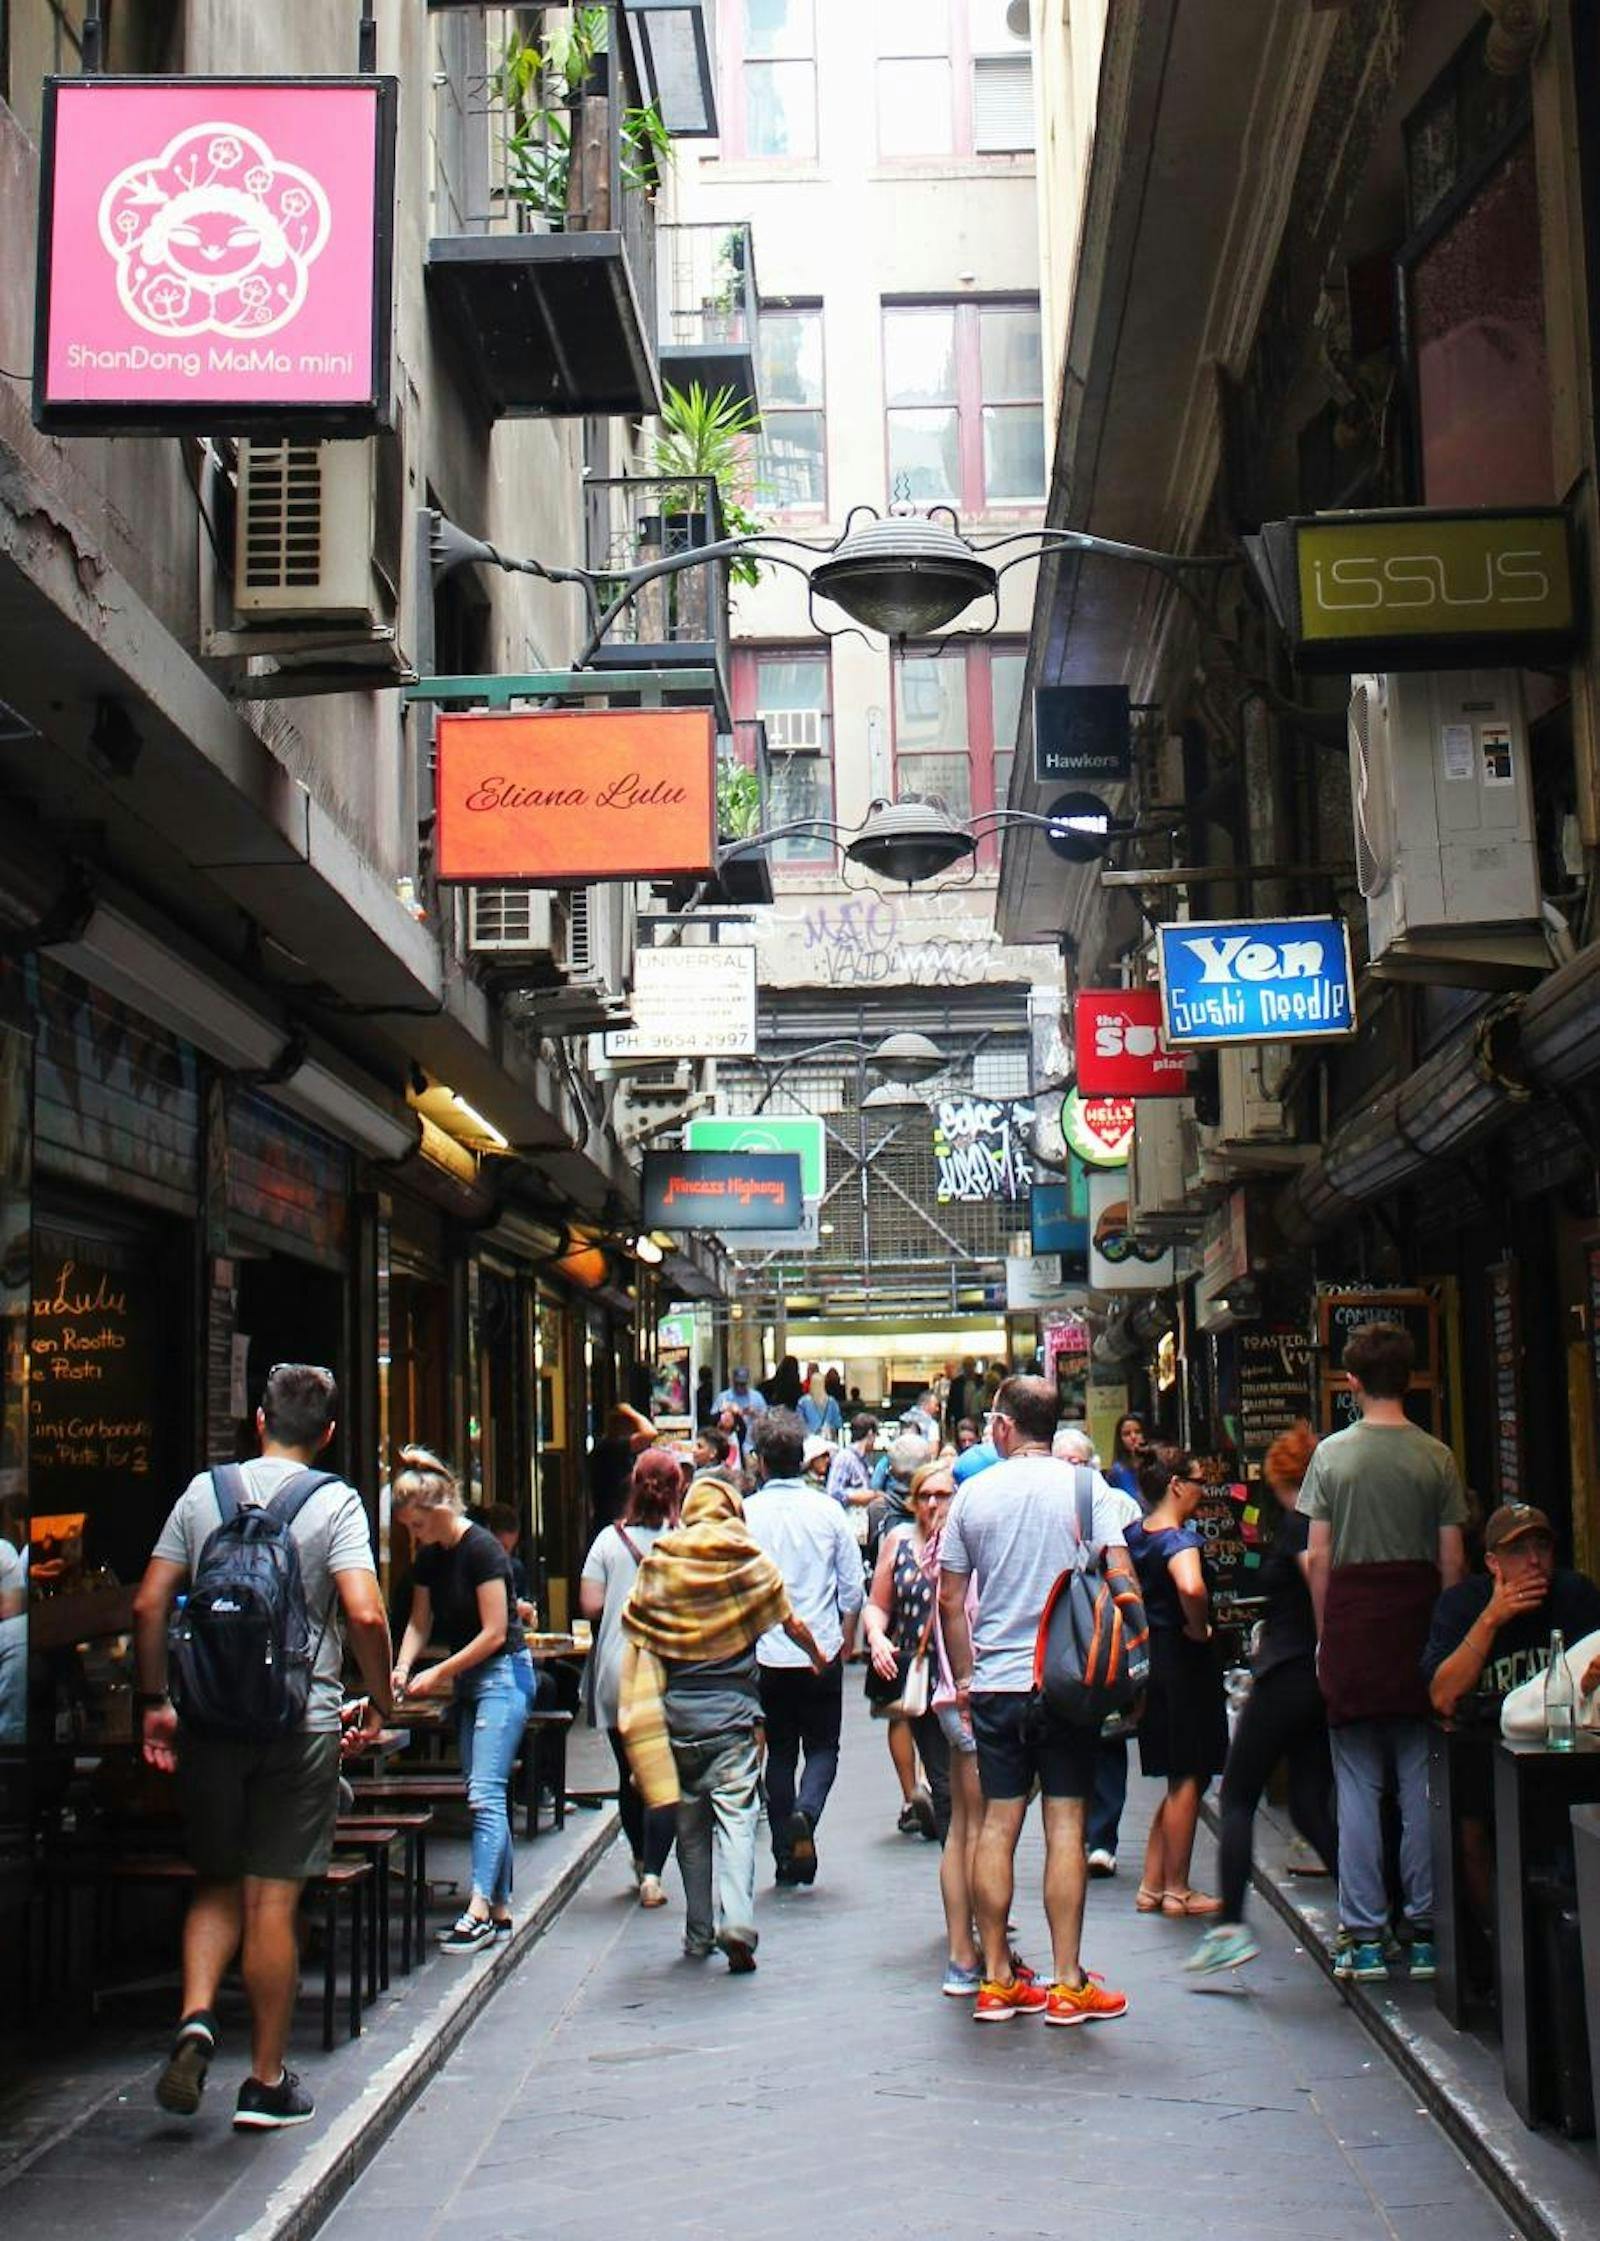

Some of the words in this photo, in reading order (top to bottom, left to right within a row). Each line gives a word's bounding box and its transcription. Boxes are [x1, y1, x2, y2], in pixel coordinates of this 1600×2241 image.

[68, 345, 200, 377] ShanDong
[209, 348, 292, 373] MaMa
[300, 352, 353, 374] mini
[1046, 753, 1120, 769] Hawkers
[465, 777, 590, 812] Eliana
[596, 773, 688, 810] Lulu
[638, 953, 749, 969] UNIVERSAL
[1181, 935, 1325, 984] Yen
[1096, 1015, 1123, 1027] the
[1171, 987, 1247, 1033] Sushi
[728, 1177, 786, 1205] Highway
